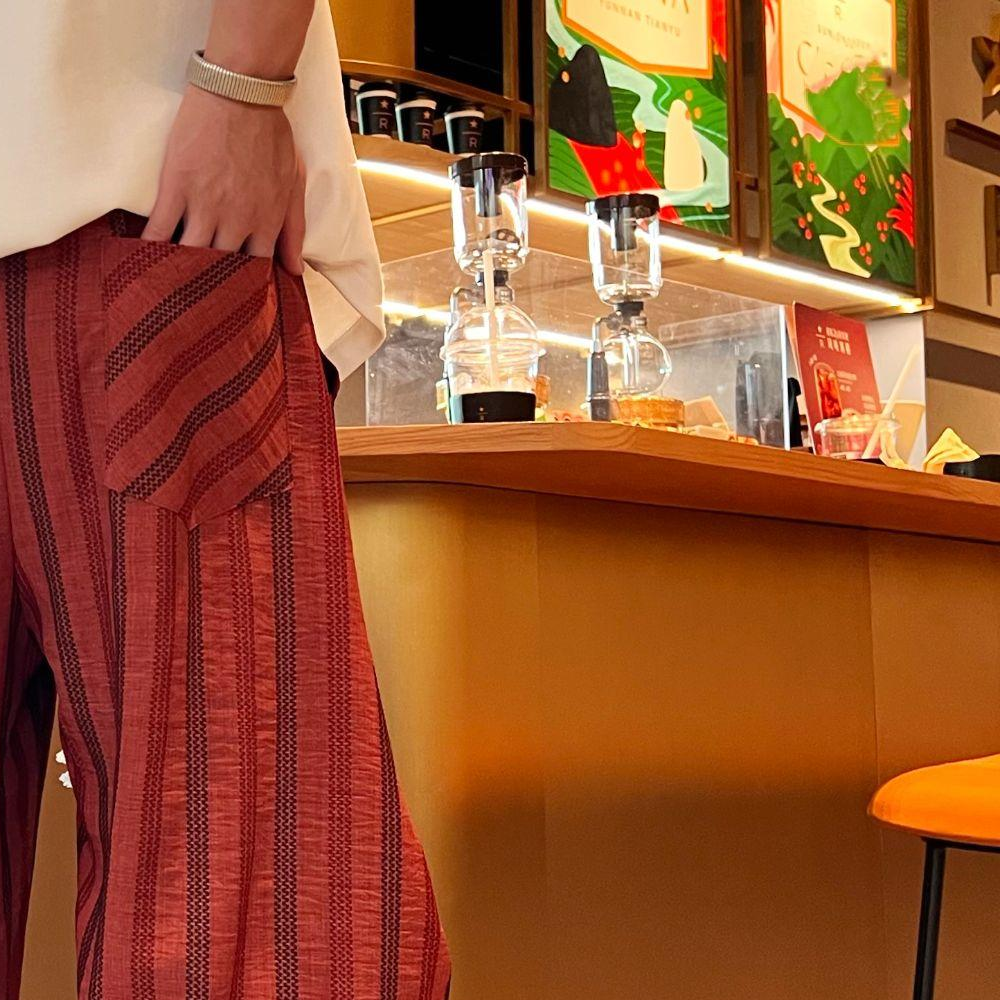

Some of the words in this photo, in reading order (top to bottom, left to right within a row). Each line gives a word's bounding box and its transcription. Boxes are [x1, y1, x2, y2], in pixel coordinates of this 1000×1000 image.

[380, 118, 388, 129] R
[422, 128, 430, 140] R
[469, 137, 477, 148] R
